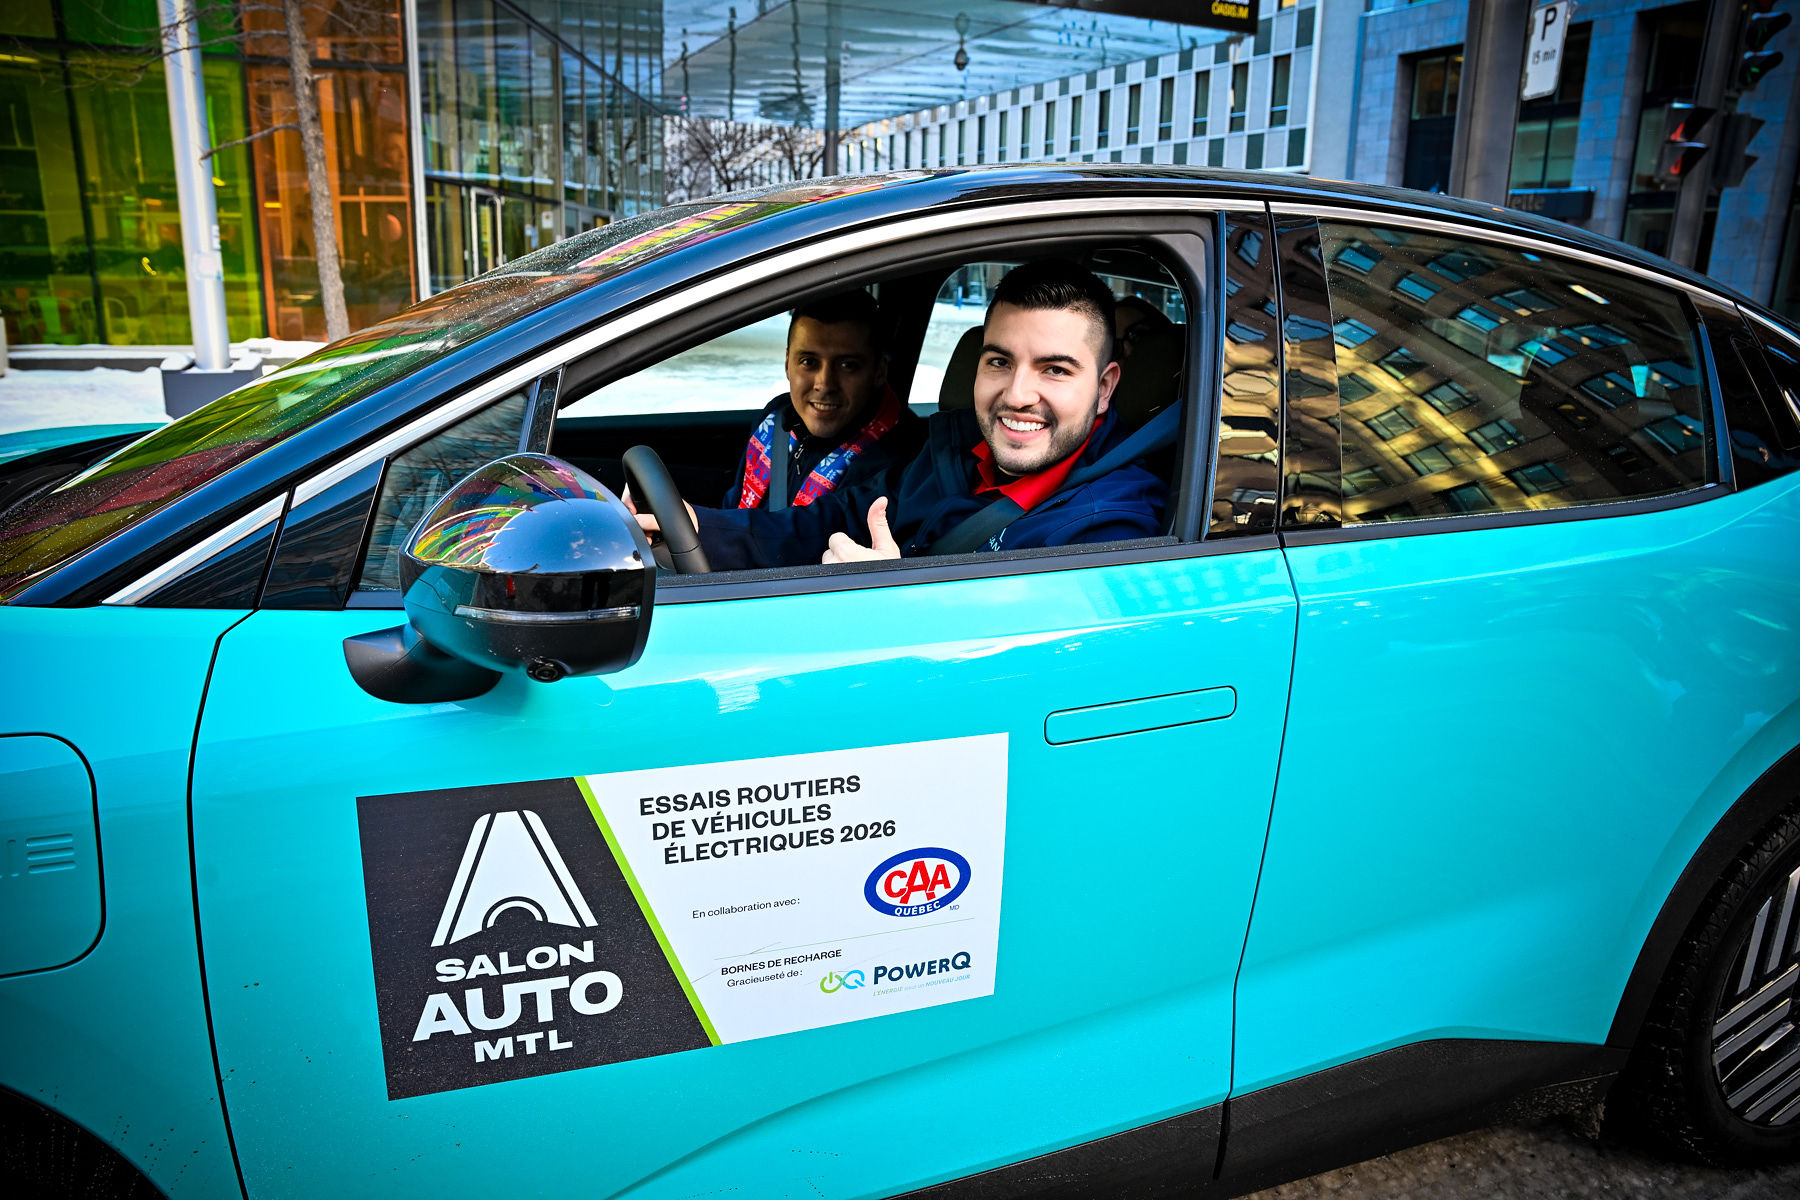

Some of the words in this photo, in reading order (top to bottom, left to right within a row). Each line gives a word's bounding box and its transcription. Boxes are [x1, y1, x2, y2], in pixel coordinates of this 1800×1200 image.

[1541, 6, 1557, 41] P
[639, 788, 731, 816] ESSAIS
[737, 775, 861, 805] ROUTIERS
[652, 819, 685, 841] DE
[692, 803, 831, 836] VÉHICULES
[664, 827, 834, 865] ÉLECTRIQUES
[840, 820, 896, 843] 2026
[884, 860, 951, 904] CAA
[692, 909, 706, 919] En
[707, 901, 772, 917] collaboration
[894, 901, 941, 916] QUÉBEC
[435, 940, 594, 983] SALON
[721, 961, 766, 976] BORNES
[767, 959, 782, 969] DE
[784, 949, 842, 966] RECHARGE
[727, 970, 785, 988] Gracieuseté
[412, 970, 623, 1042] AUTO
[474, 1030, 573, 1063] MTL
